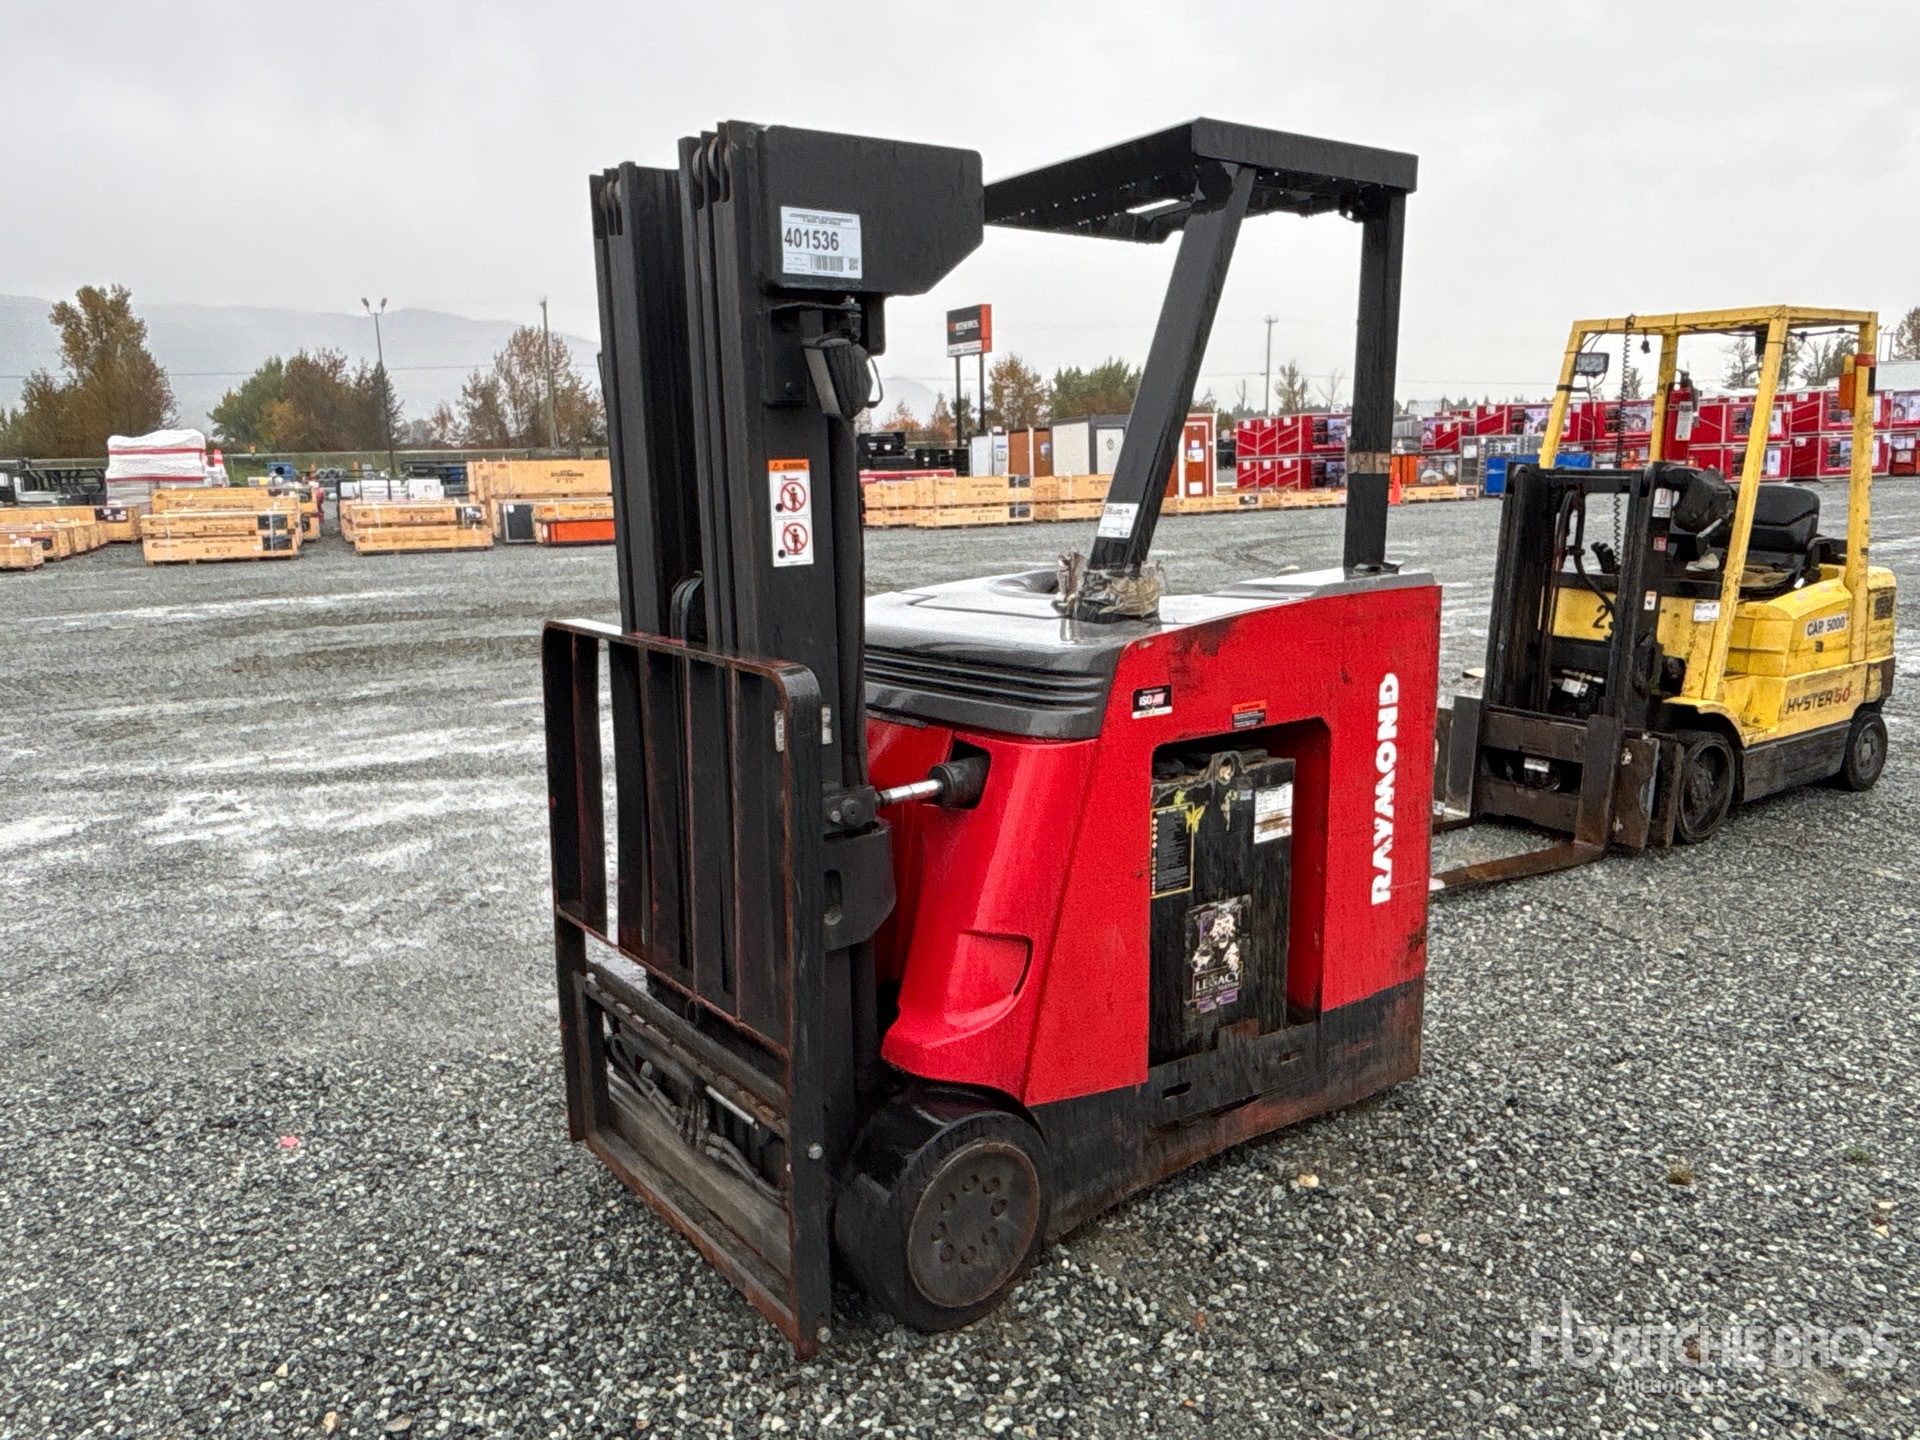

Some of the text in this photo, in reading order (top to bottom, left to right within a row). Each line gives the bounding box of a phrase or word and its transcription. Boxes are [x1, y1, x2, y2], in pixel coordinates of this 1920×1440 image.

[784, 227, 839, 251] 401536
[1826, 616, 1846, 632] 5000
[1786, 690, 1833, 714] HYSTER
[1371, 672, 1399, 906] RAYMOND
[1195, 971, 1241, 992] LEGACY
